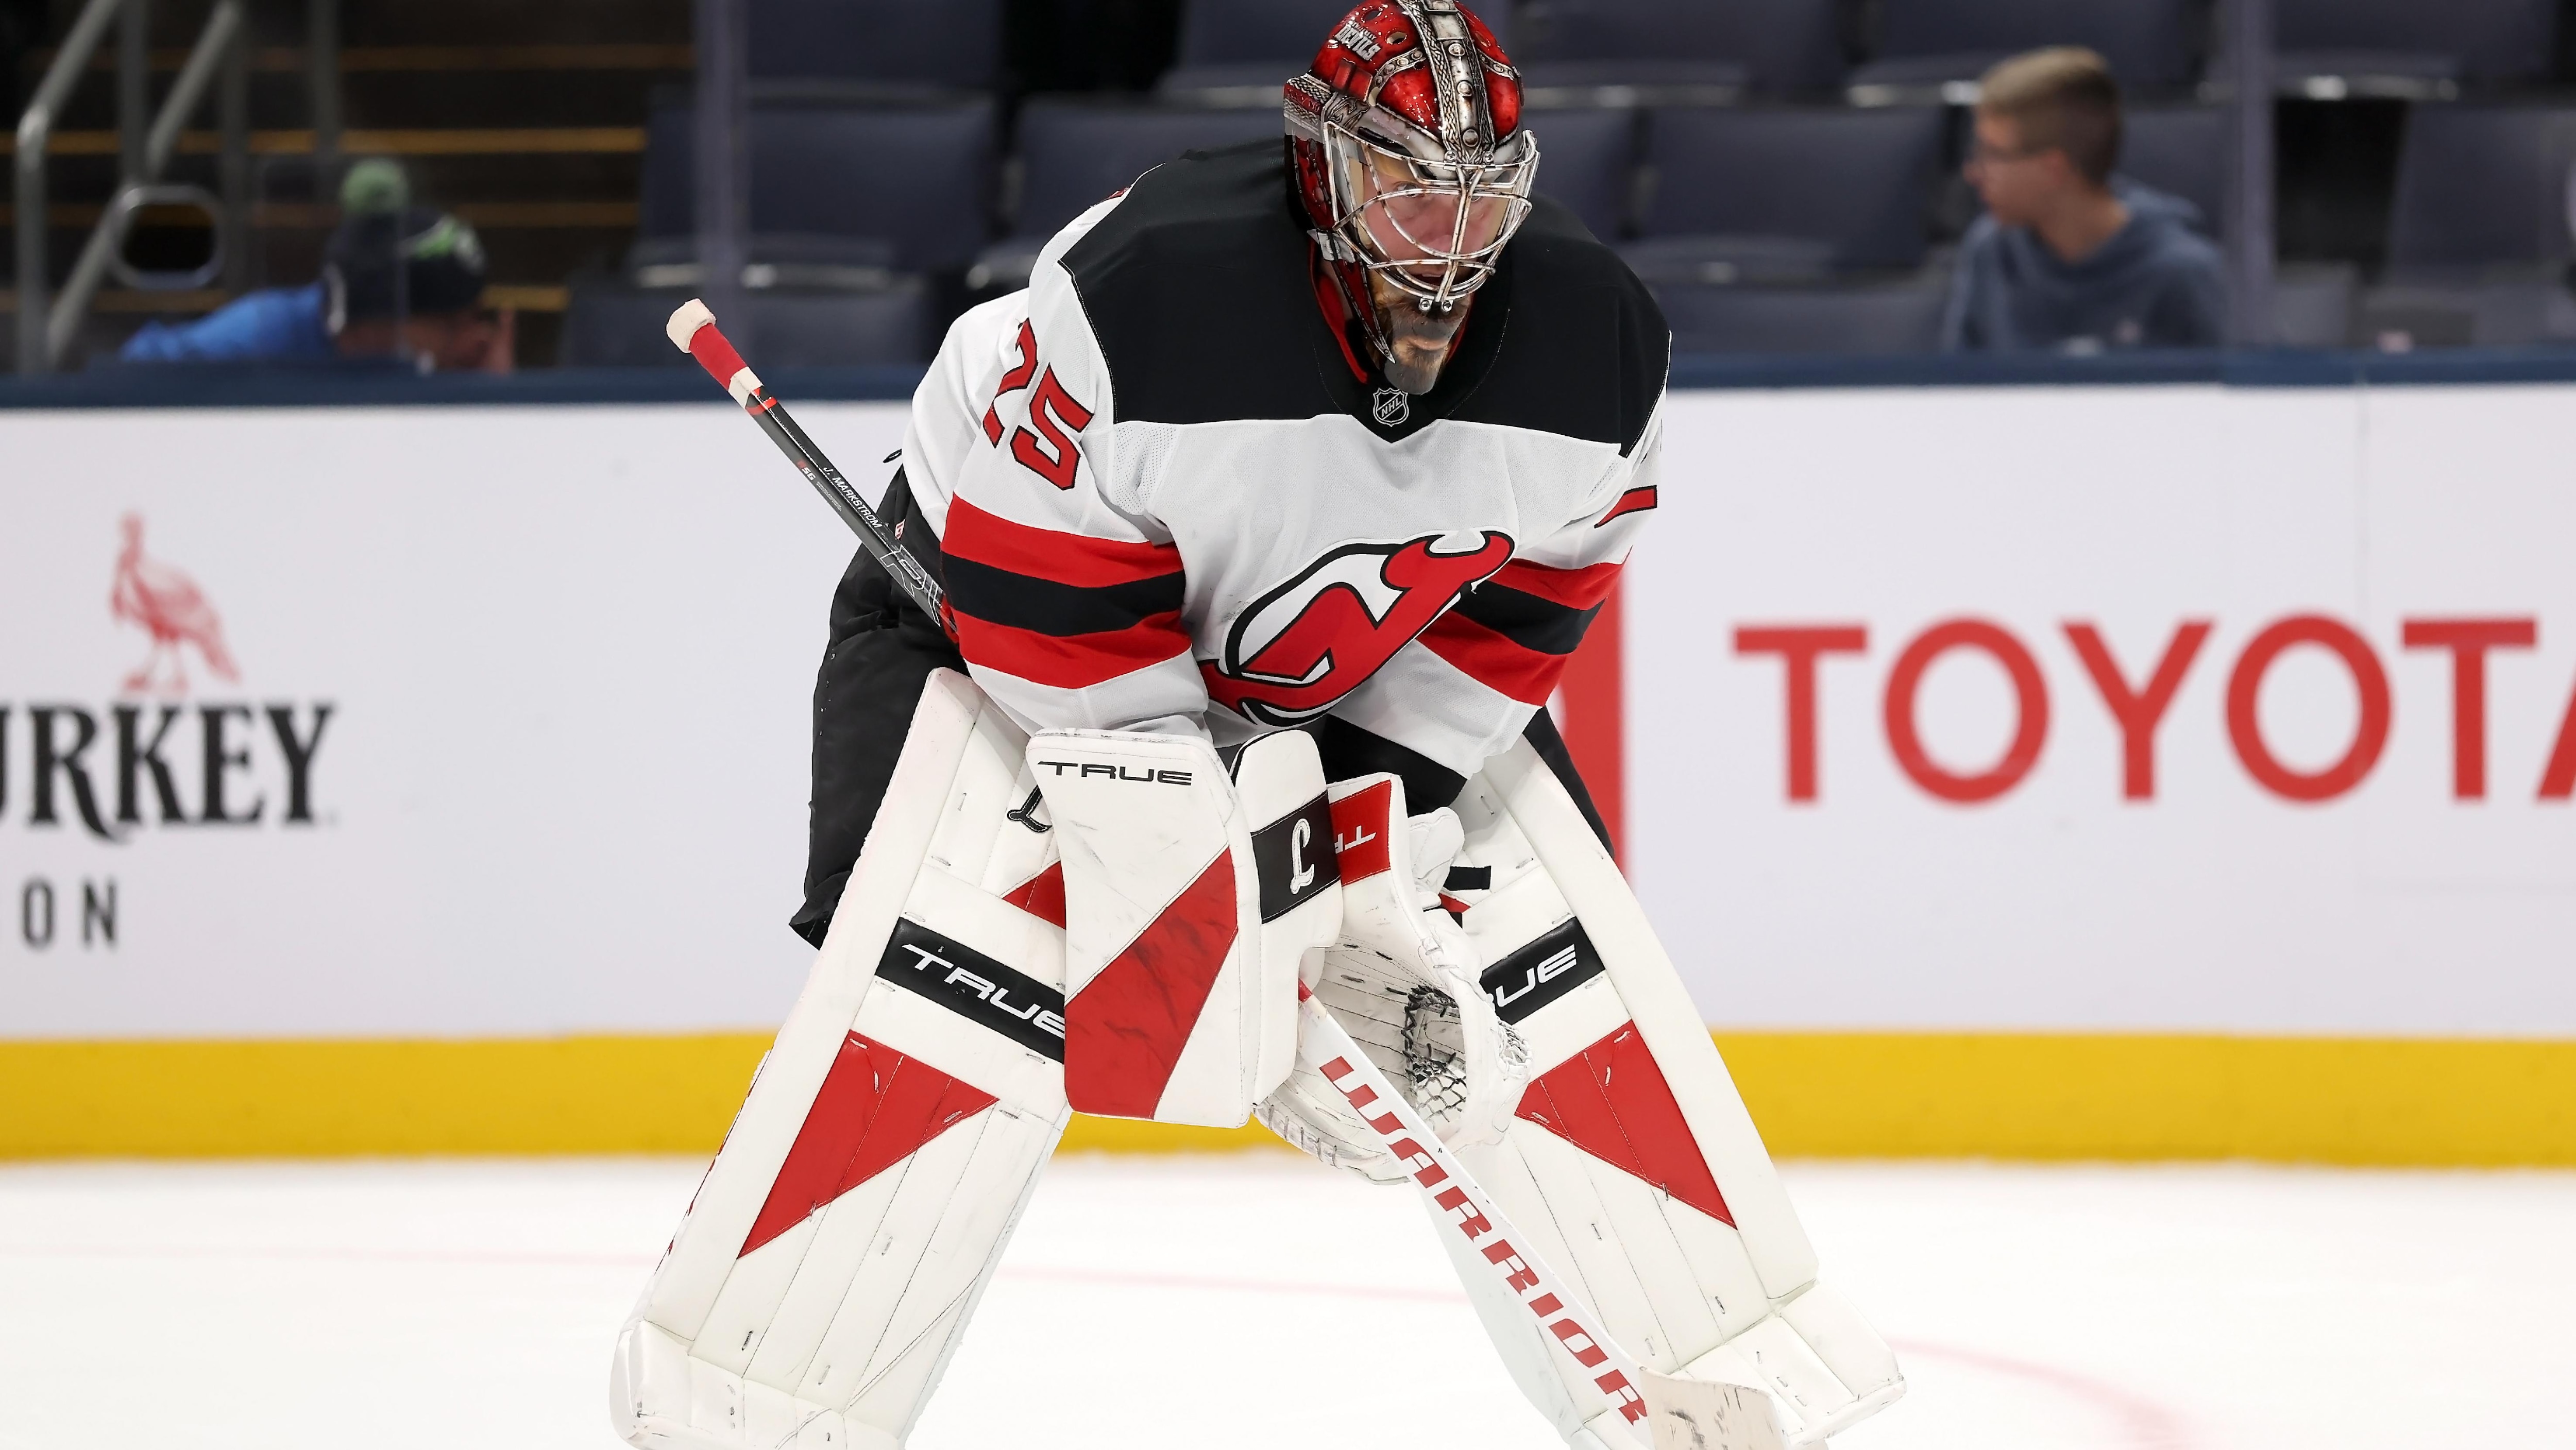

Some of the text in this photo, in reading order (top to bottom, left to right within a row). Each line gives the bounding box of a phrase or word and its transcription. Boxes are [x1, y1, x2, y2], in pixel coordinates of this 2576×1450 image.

[1334, 23, 1381, 60] DEVILS
[982, 317, 1094, 490] 25
[1381, 398, 1401, 417] NHL
[832, 477, 883, 528] MARKSTROM
[1038, 761, 1192, 786] TRUE
[902, 944, 1065, 1039] TRUE
[1486, 944, 1577, 1007] UE
[1318, 1056, 1648, 1426] WARRIOR
